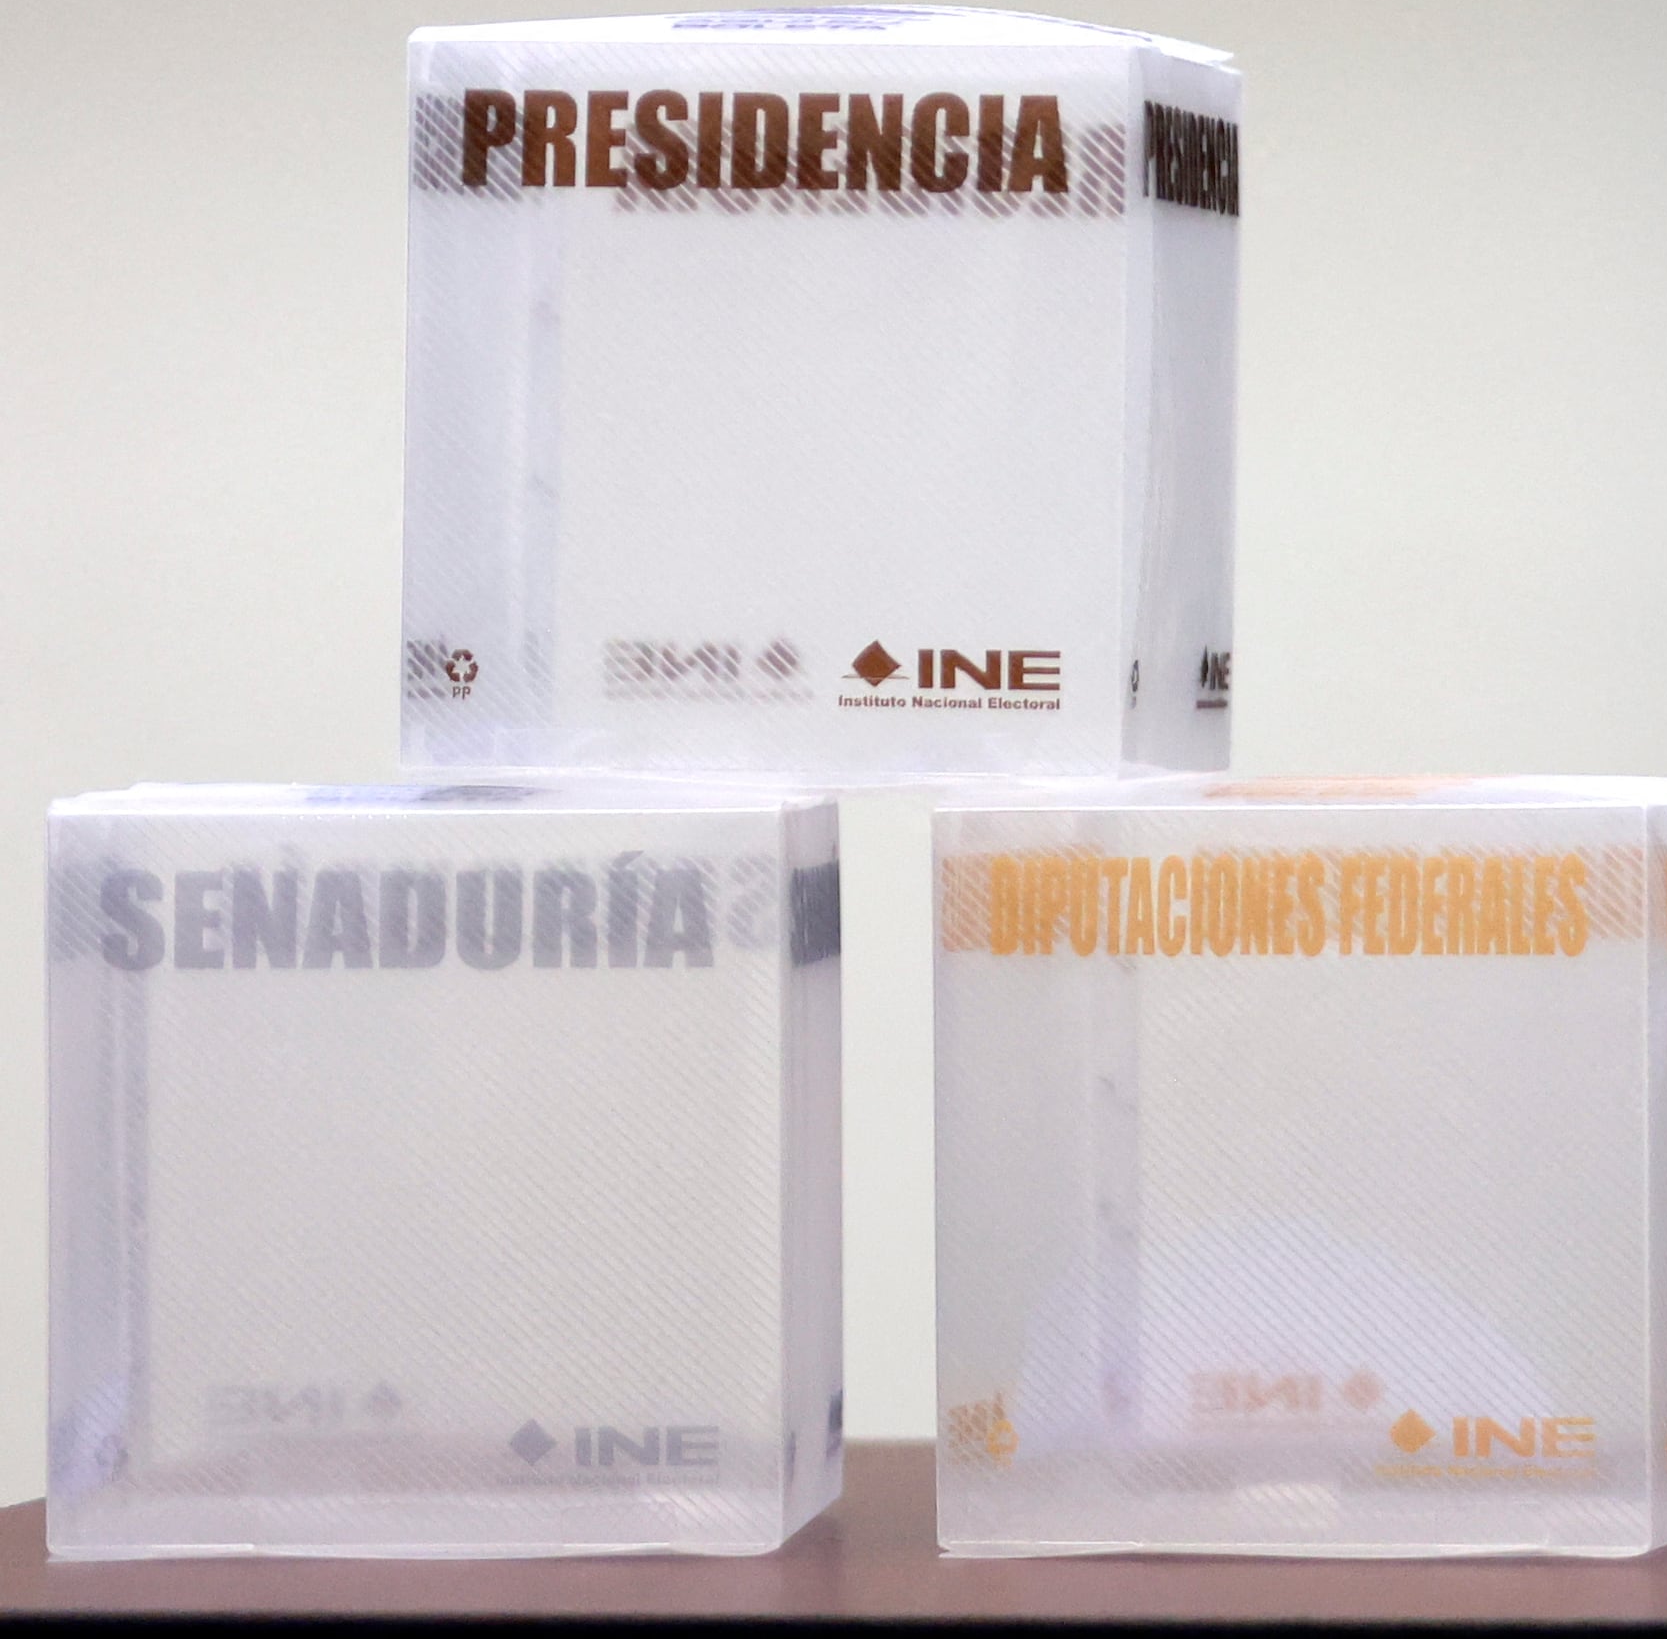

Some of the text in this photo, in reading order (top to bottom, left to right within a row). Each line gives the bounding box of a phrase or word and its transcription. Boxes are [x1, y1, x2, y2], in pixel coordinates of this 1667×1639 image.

[461, 88, 1069, 194] PRESIDENCIA
[918, 649, 1061, 690] INE
[838, 695, 1061, 710] Instituto Nacional Electoral
[100, 849, 715, 972] SENADURÍA
[990, 852, 1327, 958] DIPUTACIONES
[1338, 852, 1590, 958] FEDERALES
[574, 1425, 720, 1467] INE
[1452, 1416, 1597, 1458] INE
